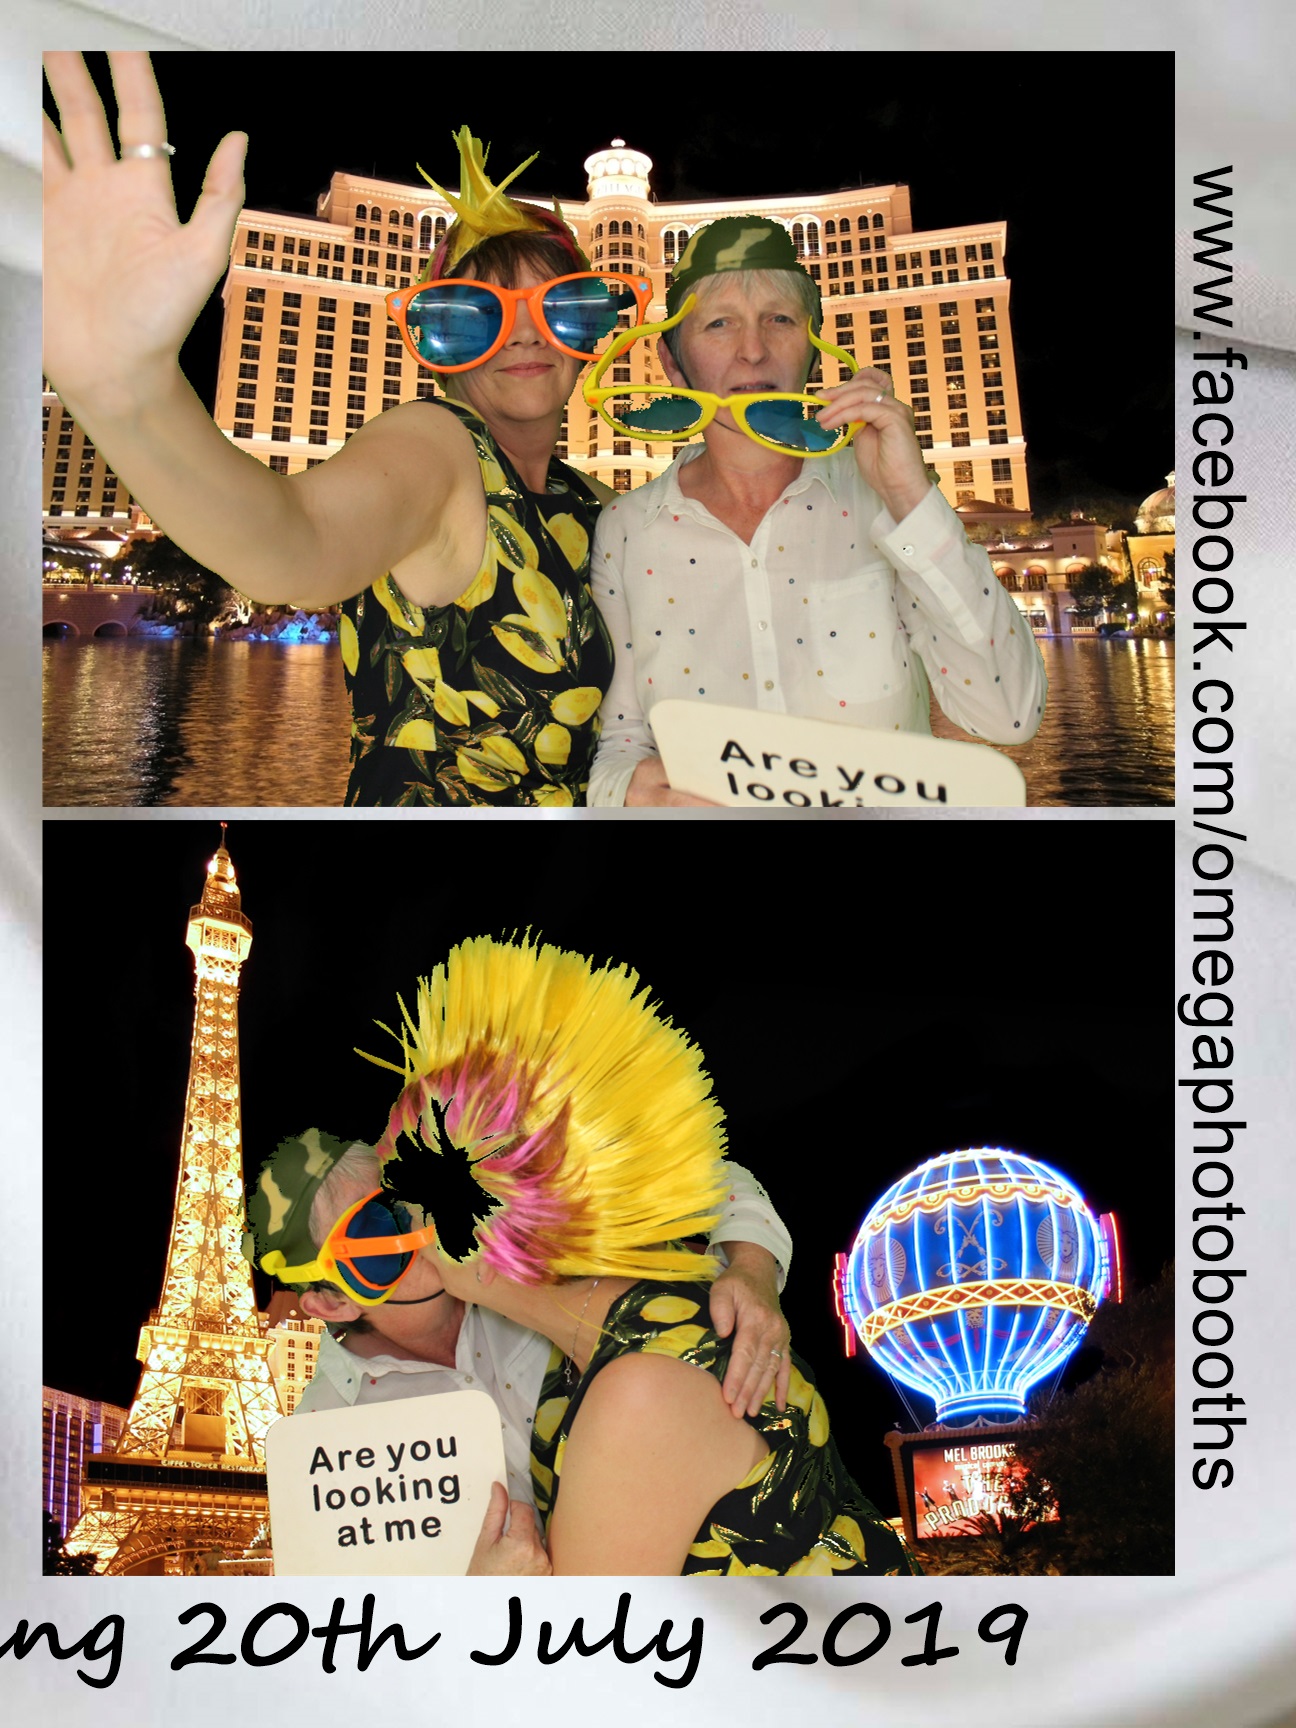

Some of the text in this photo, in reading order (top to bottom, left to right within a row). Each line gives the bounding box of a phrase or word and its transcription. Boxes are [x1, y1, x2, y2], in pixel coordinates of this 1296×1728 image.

[720, 740, 948, 804] Are you
[161, 1459, 189, 1468] EIFFEL
[190, 1460, 218, 1470] TOWER
[309, 1436, 457, 1475] Are you
[944, 1448, 967, 1462] MEL
[313, 1474, 460, 1512] looking
[338, 1516, 442, 1547] at me
